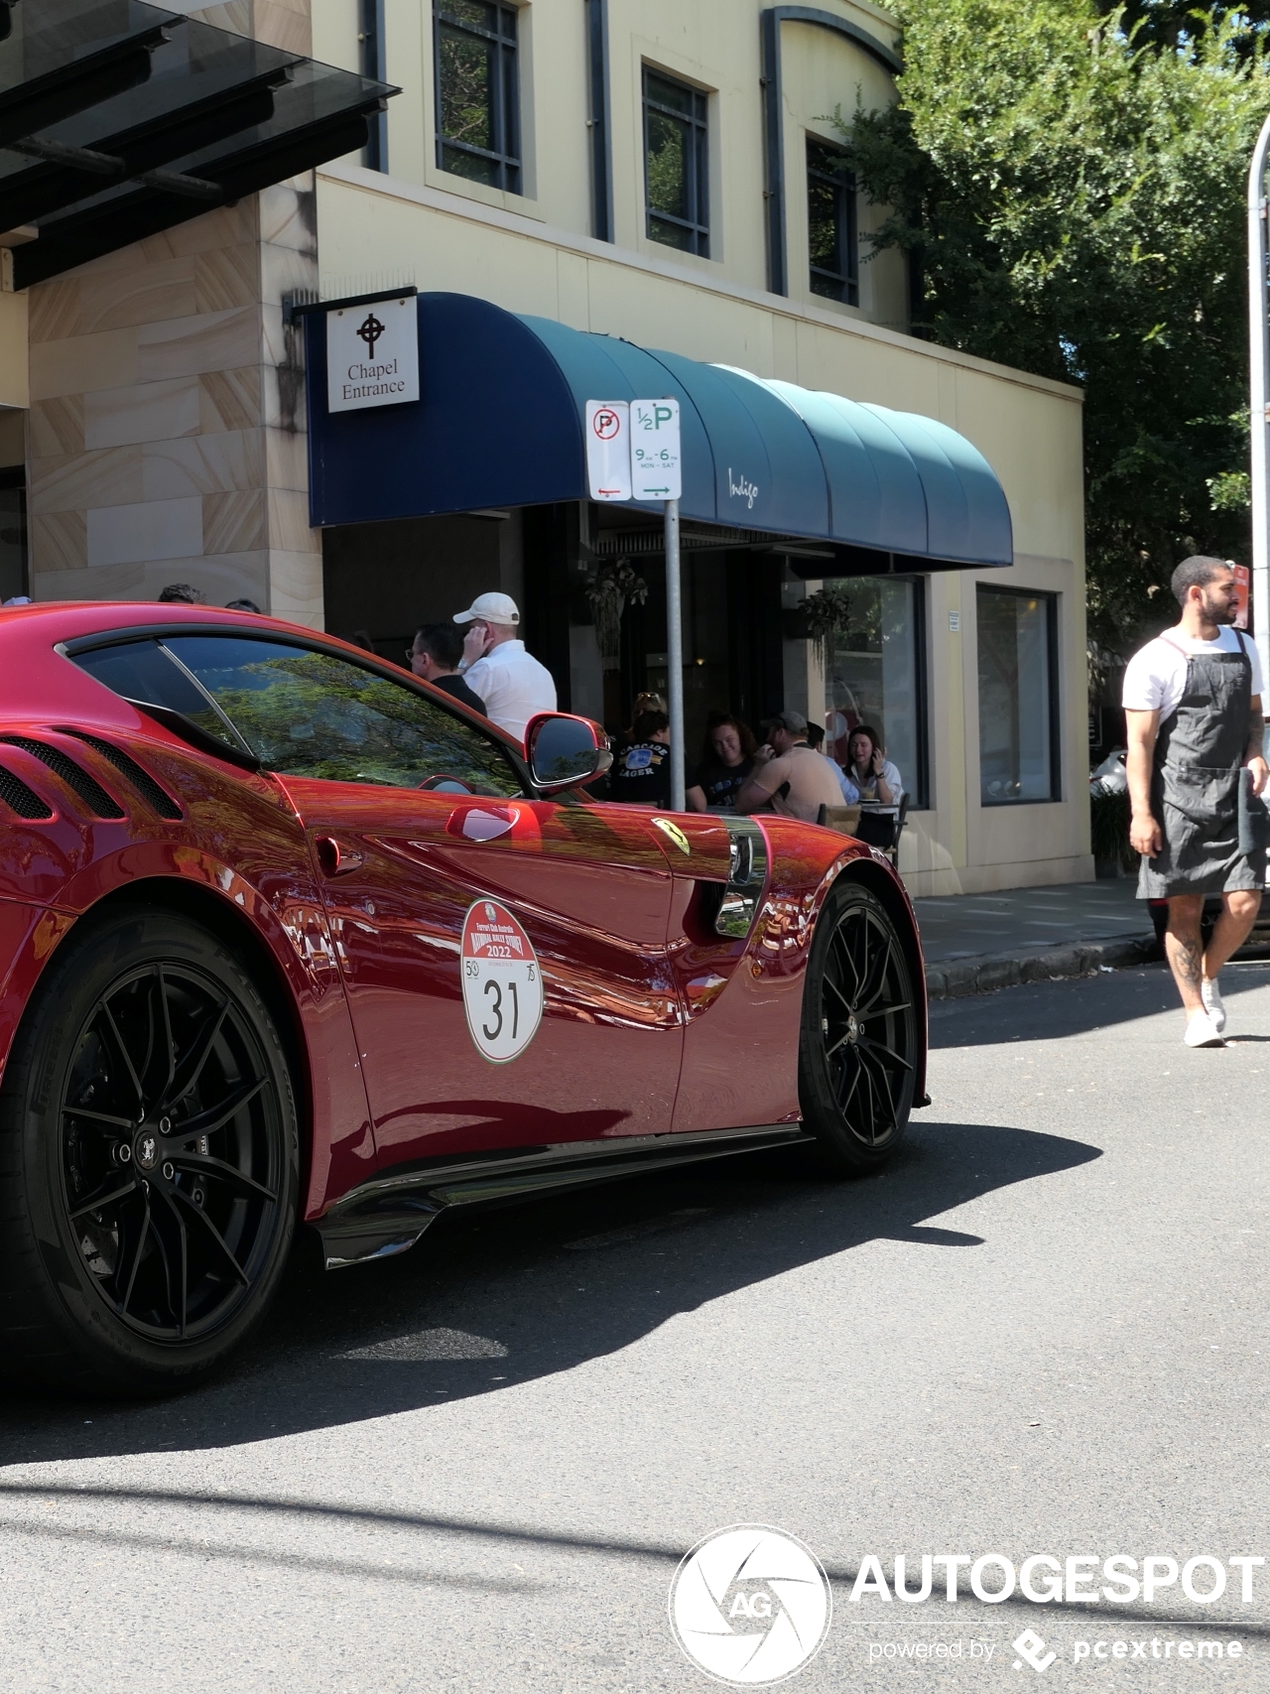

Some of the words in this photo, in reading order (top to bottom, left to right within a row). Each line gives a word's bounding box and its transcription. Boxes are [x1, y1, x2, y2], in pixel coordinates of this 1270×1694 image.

[348, 359, 398, 380] Chapel
[342, 381, 405, 400] Entrance
[728, 468, 759, 509] Indigo
[620, 743, 668, 756] CASCADE
[618, 768, 655, 778] LAGER
[487, 945, 512, 958] 2022
[483, 979, 519, 1041] 31
